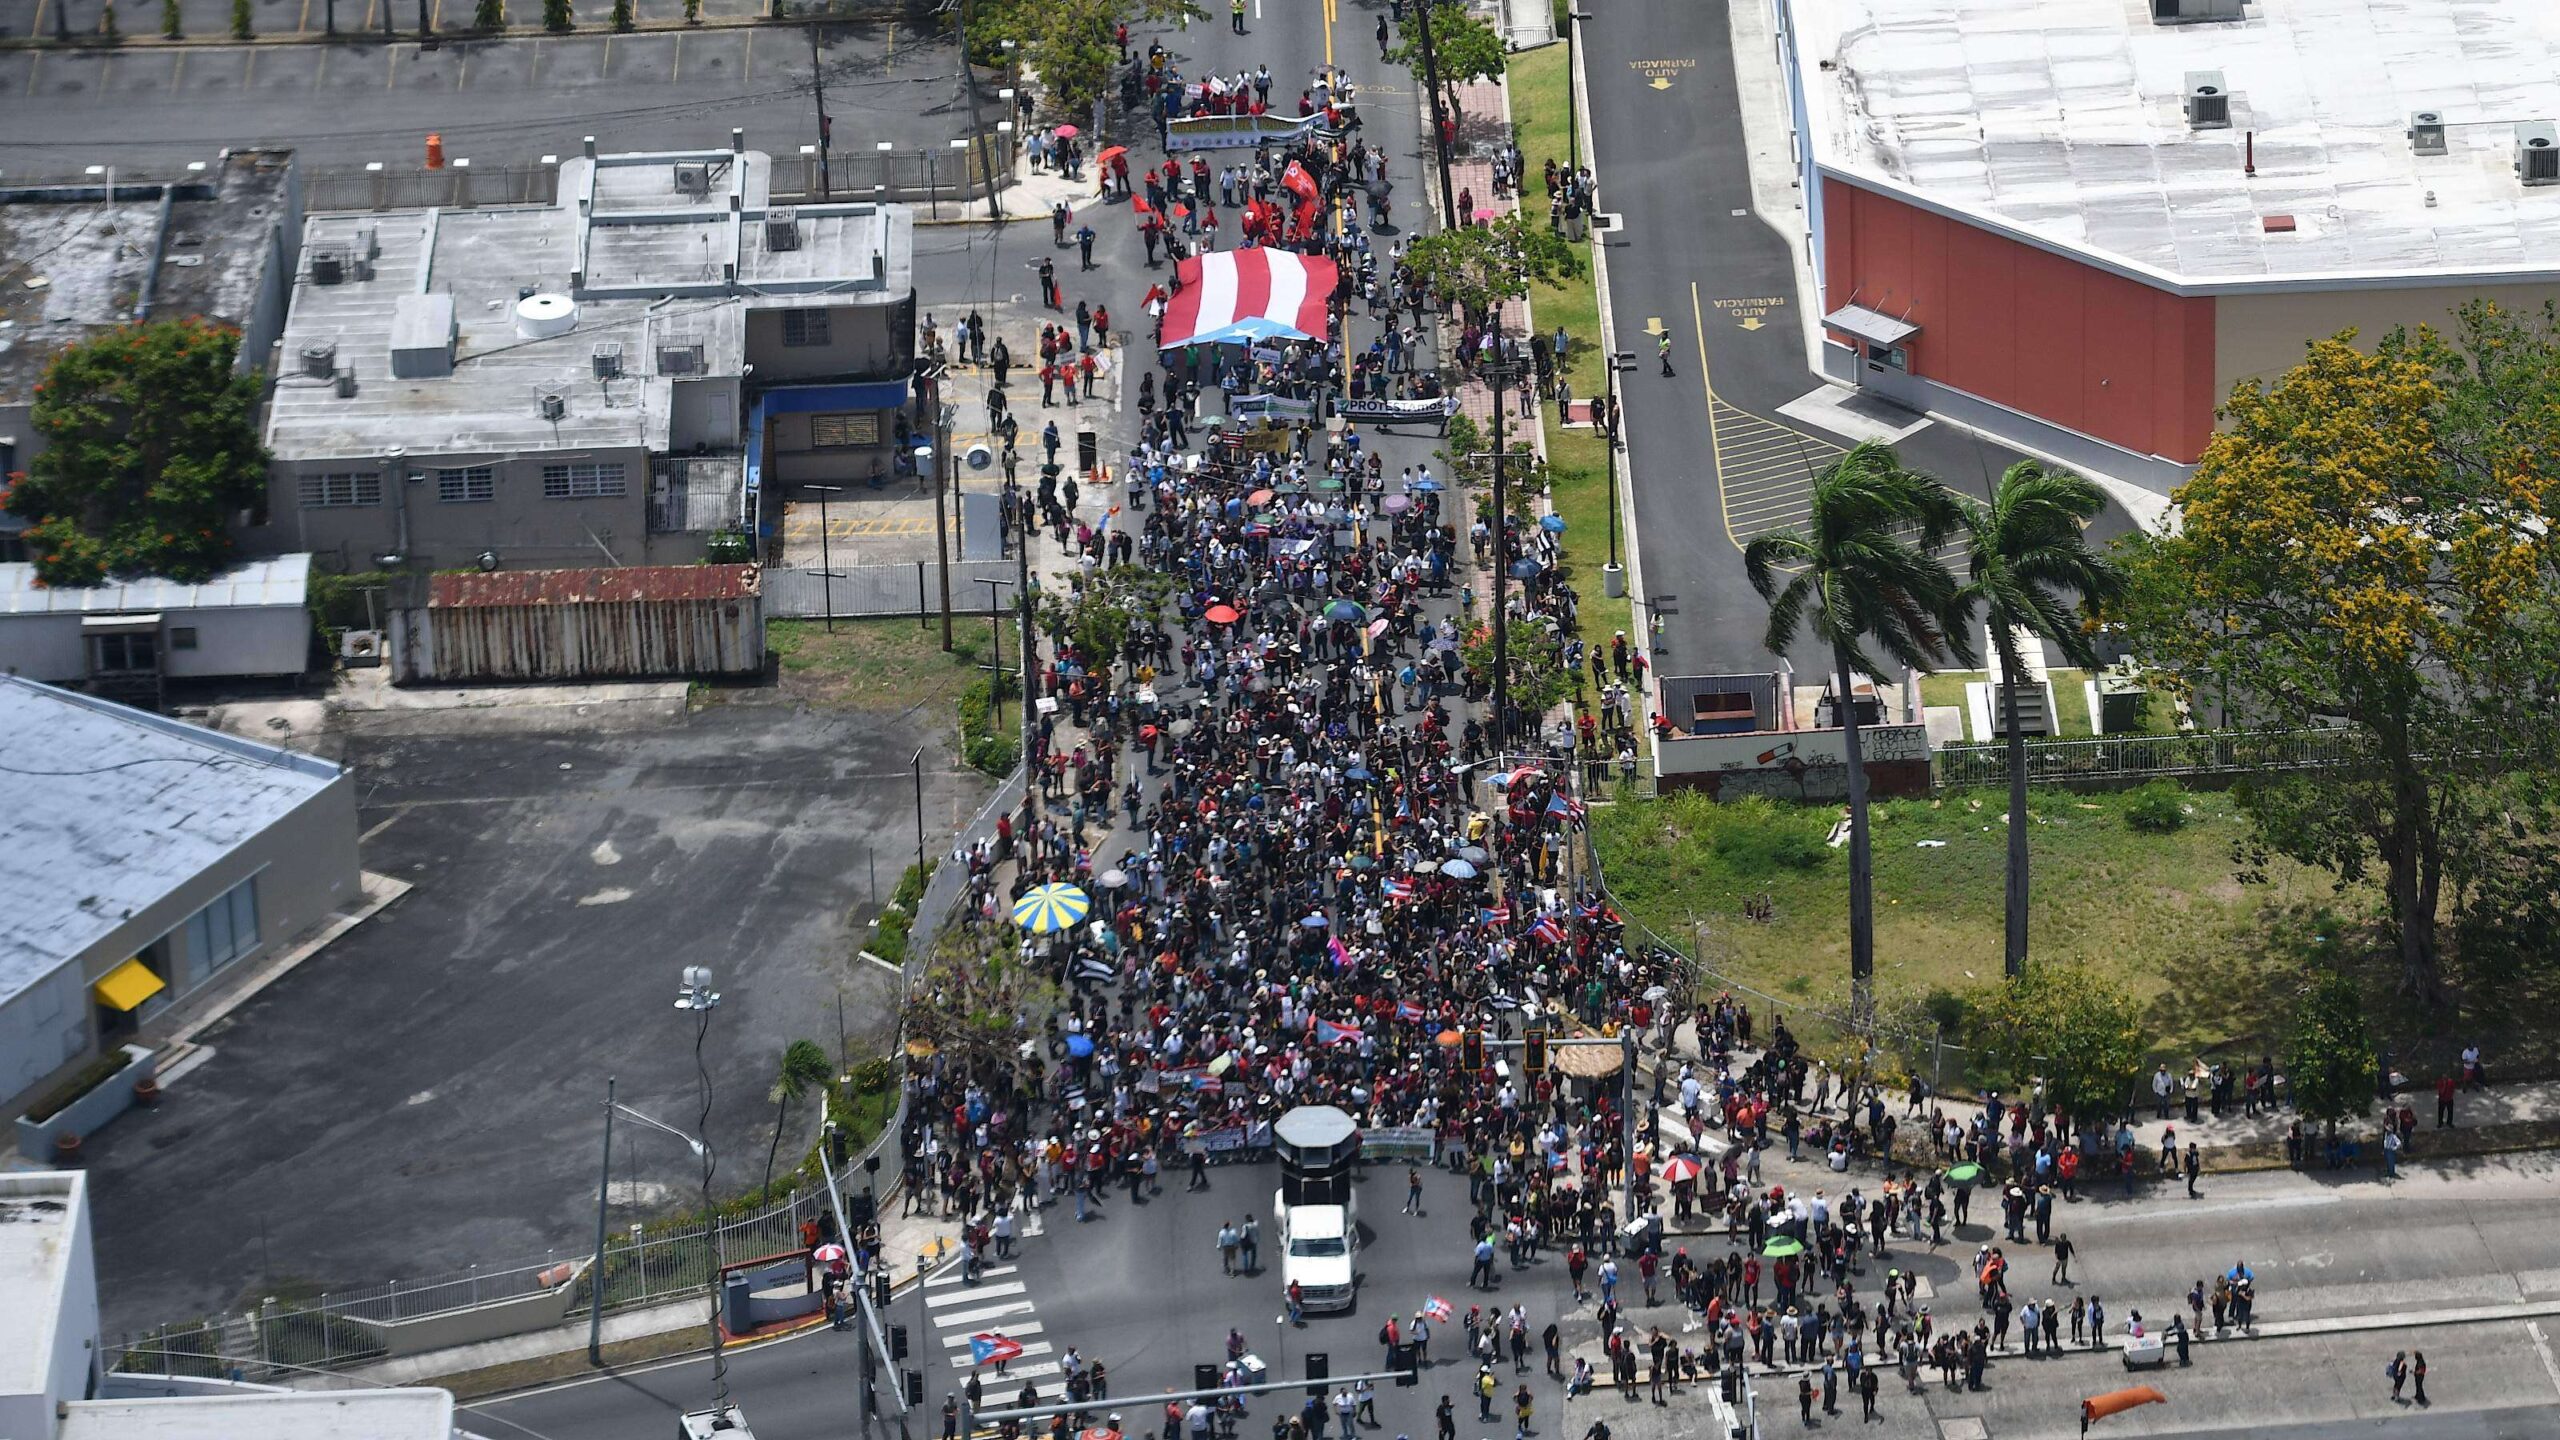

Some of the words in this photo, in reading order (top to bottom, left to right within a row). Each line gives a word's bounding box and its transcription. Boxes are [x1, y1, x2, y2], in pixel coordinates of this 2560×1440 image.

[1629, 59, 1695, 69] FARMACIA
[1645, 69, 1678, 77] AUTO
[1713, 297, 1784, 308] FARMACIA
[1732, 308, 1767, 316] AUTO
